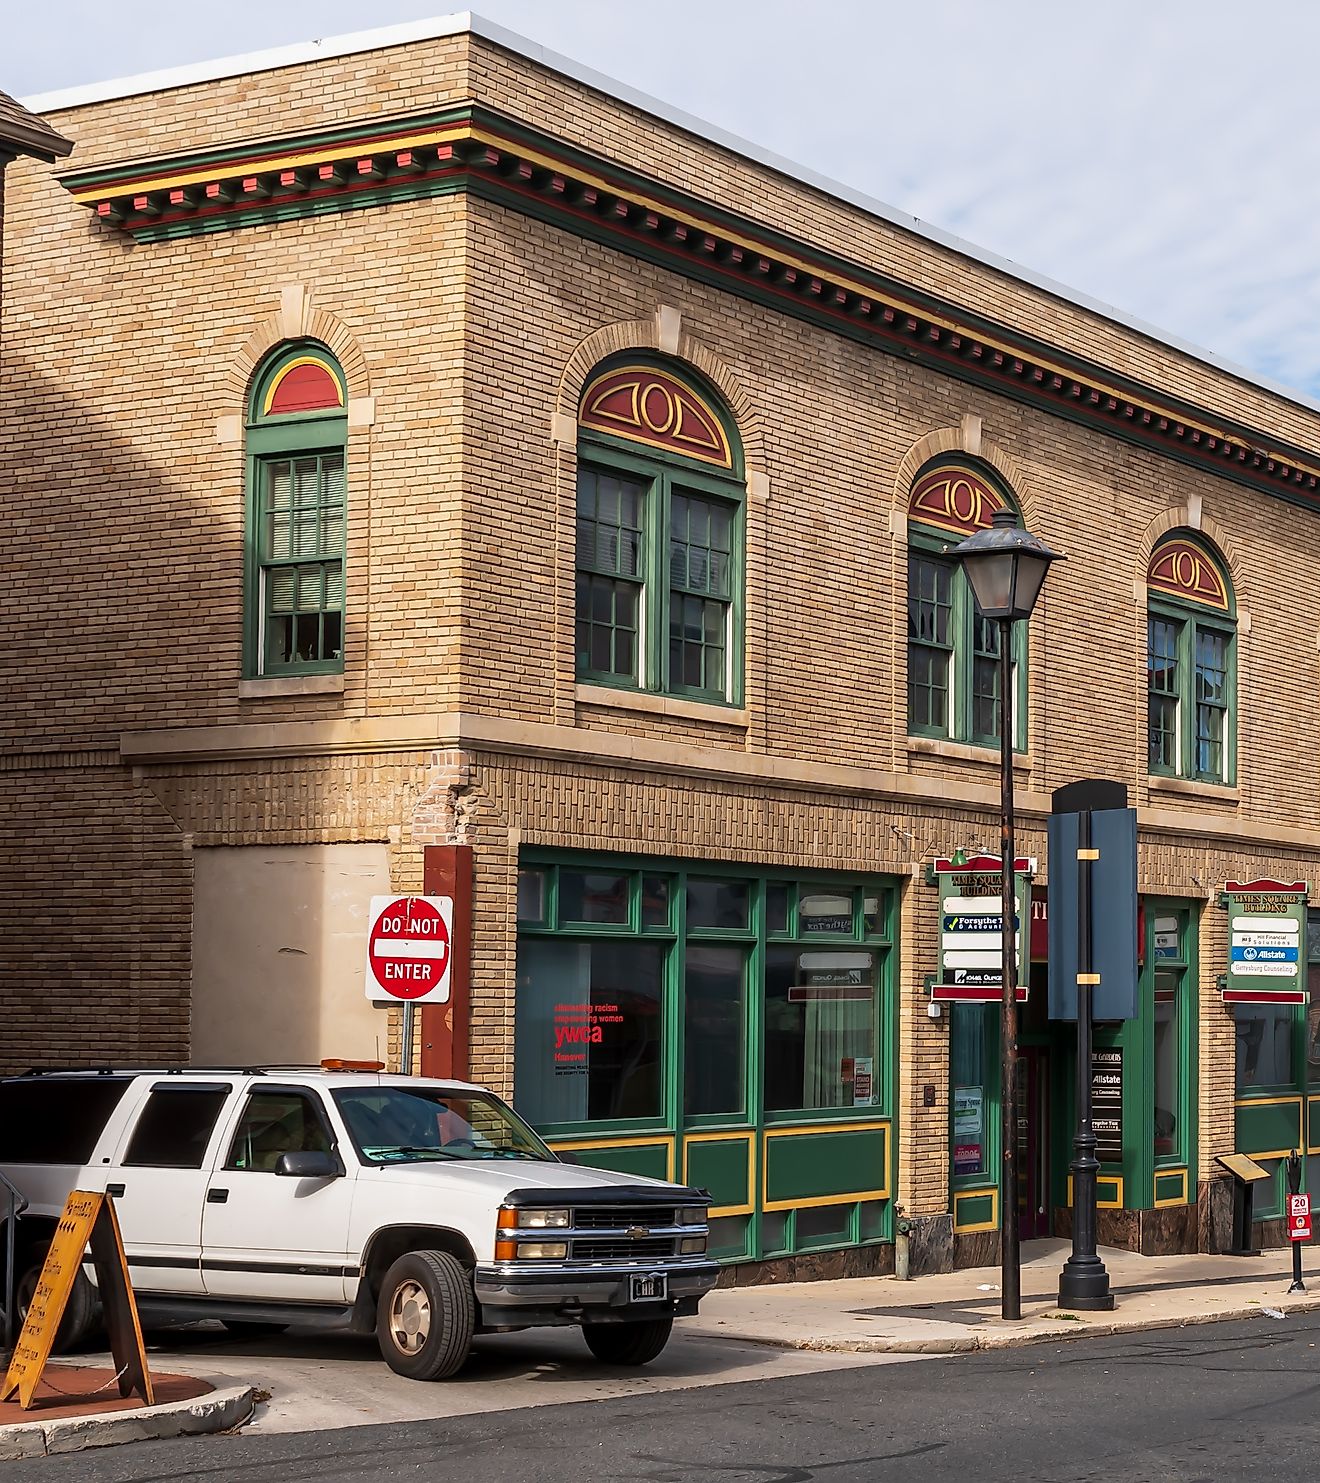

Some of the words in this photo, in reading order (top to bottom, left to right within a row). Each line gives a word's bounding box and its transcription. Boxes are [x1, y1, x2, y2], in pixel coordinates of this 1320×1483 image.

[979, 875, 1002, 885] SQUA
[1234, 894, 1262, 904] TIMES
[1263, 895, 1299, 904] SQUARE
[1244, 904, 1288, 913] BUILDING
[382, 917, 401, 933] DO
[410, 919, 439, 935] NOT
[959, 917, 998, 925] Forsythe
[1258, 951, 1286, 959] Allstate
[385, 962, 431, 980] ENTER
[594, 1003, 618, 1012] racism
[554, 1025, 603, 1049] ywca
[1093, 1075, 1120, 1084] Allstate
[1294, 1198, 1306, 1208] 20
